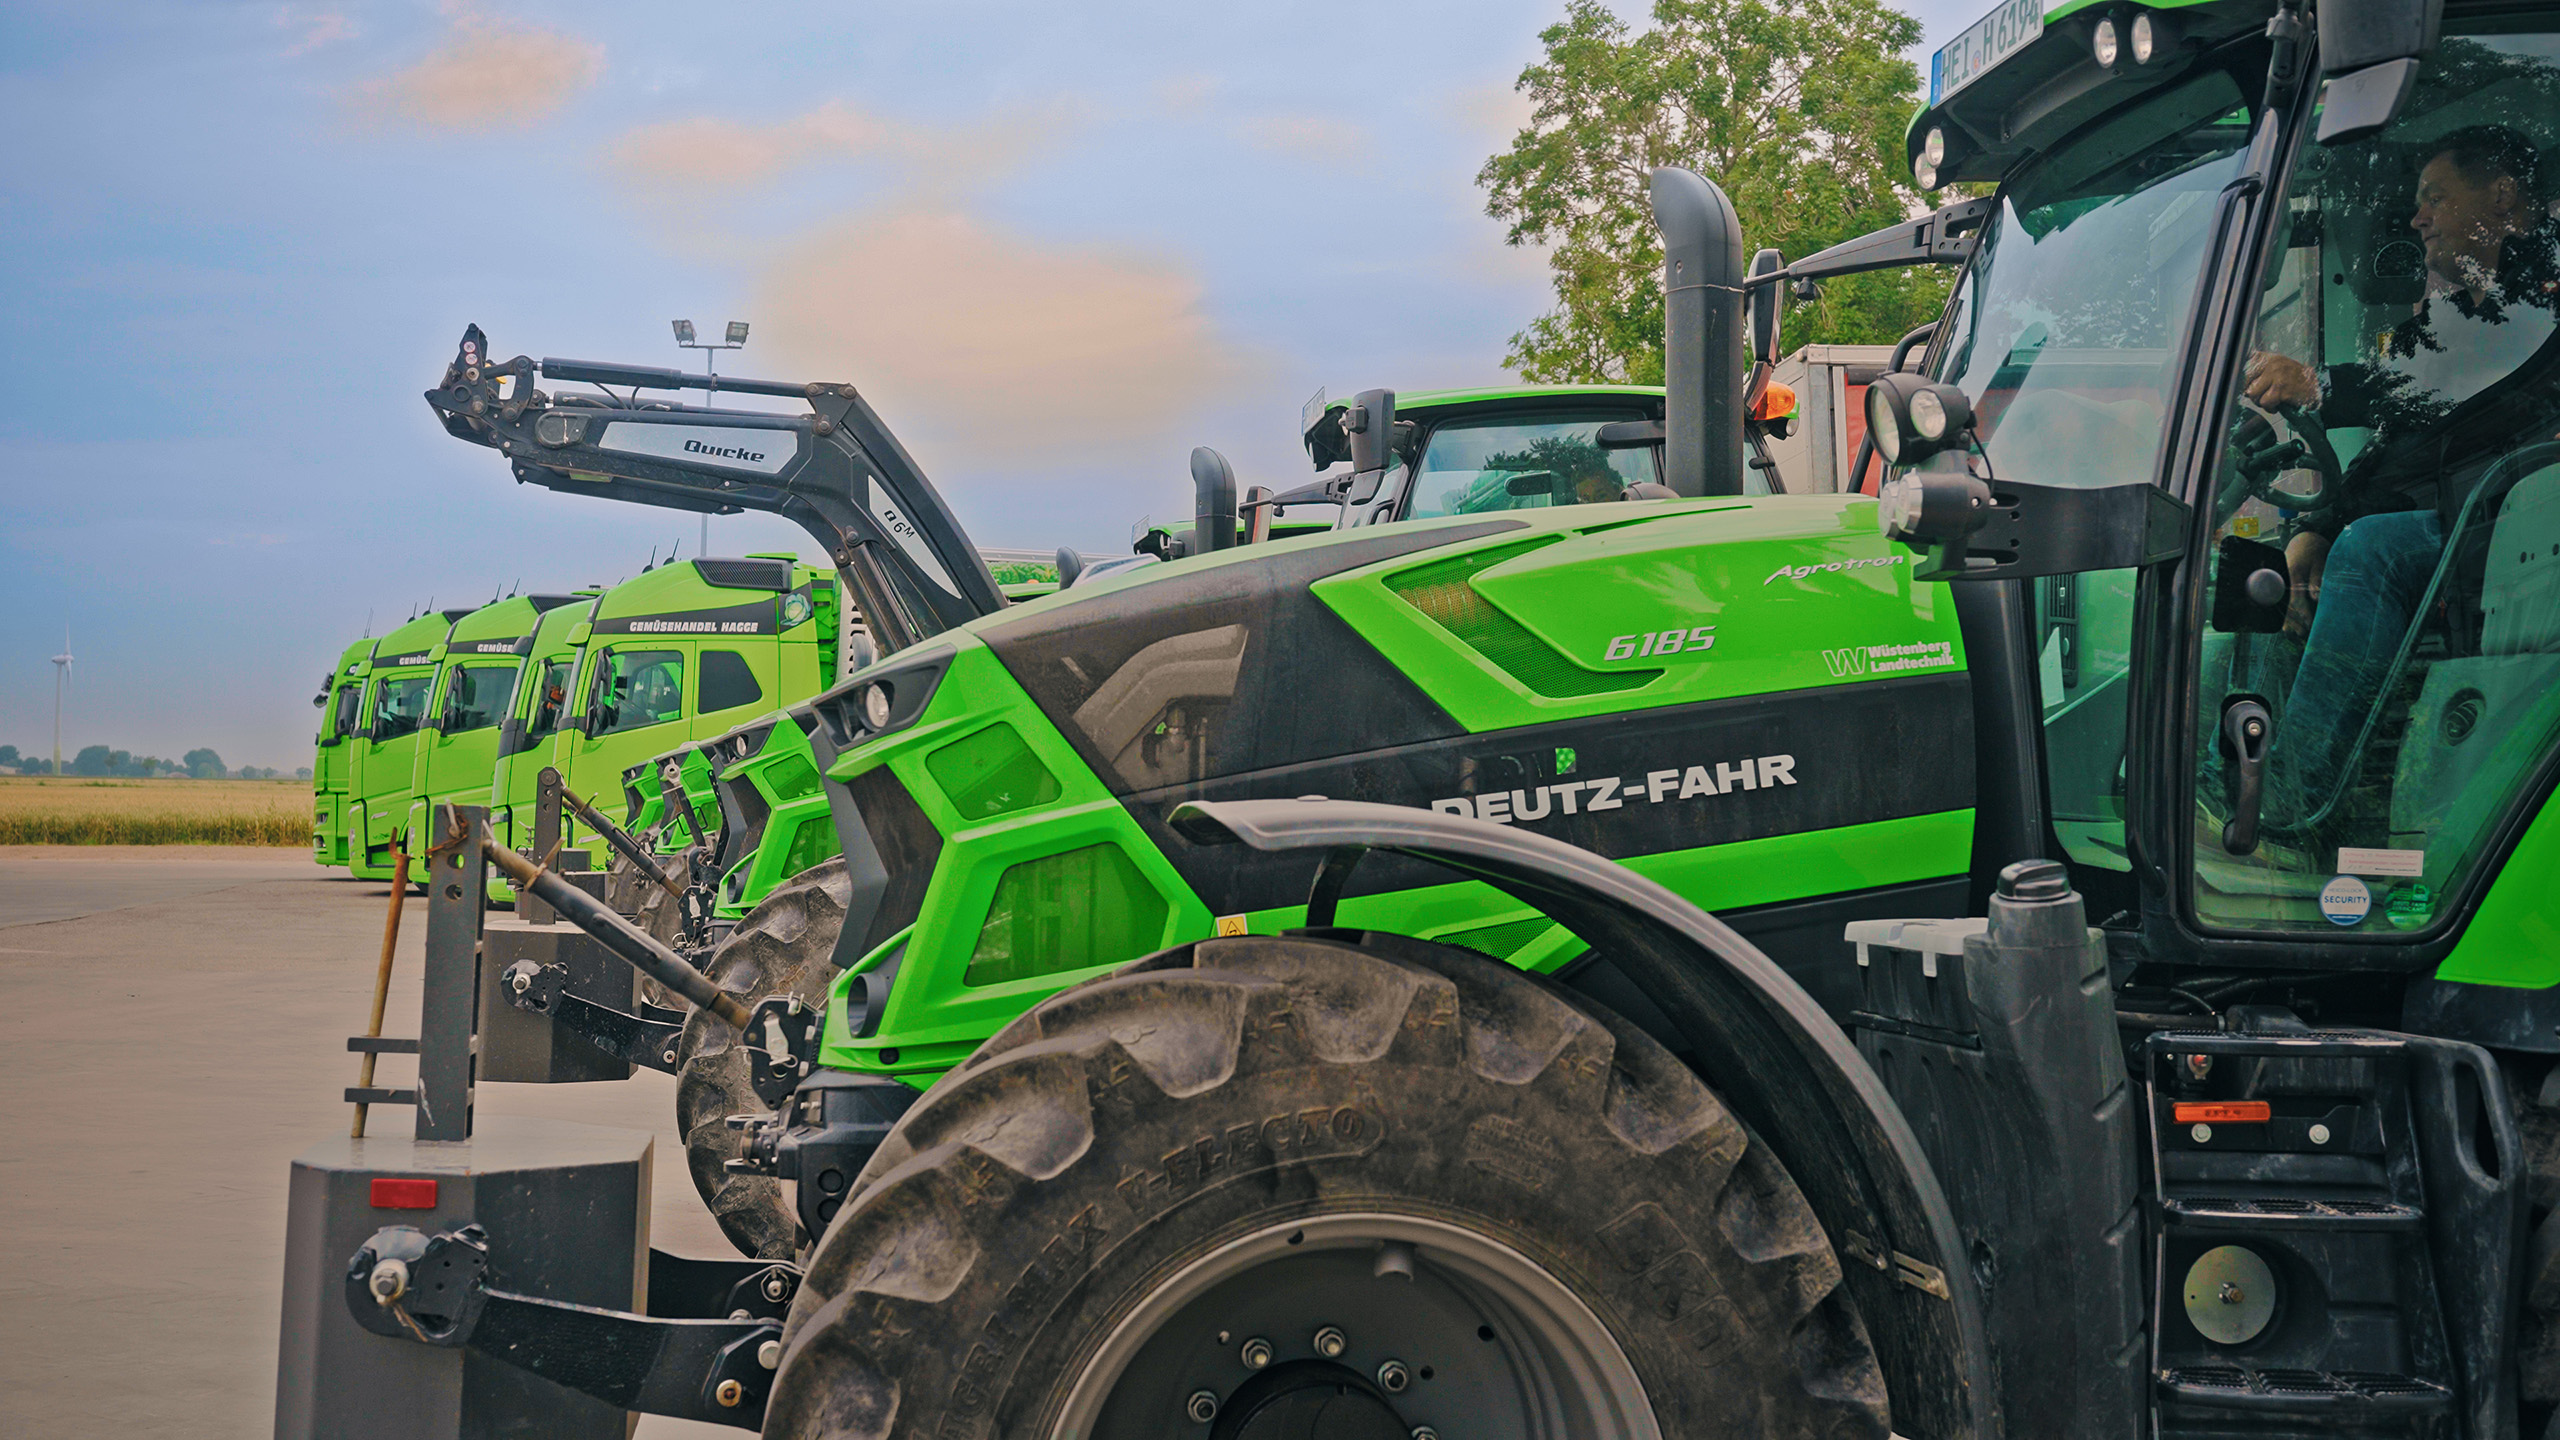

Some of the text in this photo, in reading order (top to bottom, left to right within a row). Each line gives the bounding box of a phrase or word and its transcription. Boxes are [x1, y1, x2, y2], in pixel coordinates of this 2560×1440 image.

[1941, 36, 1969, 94] HEI
[684, 439, 766, 463] Quicke
[1763, 555, 1904, 587] Agrotron
[629, 619, 759, 633] GEMÜSEHANDEL HAGGE
[1603, 625, 1717, 661] 6185
[1867, 641, 1952, 659] Wüstenberg
[399, 654, 432, 666] GEMÜS
[1871, 653, 1956, 674] Landtechnik
[2324, 895, 2368, 904] SECURITY
